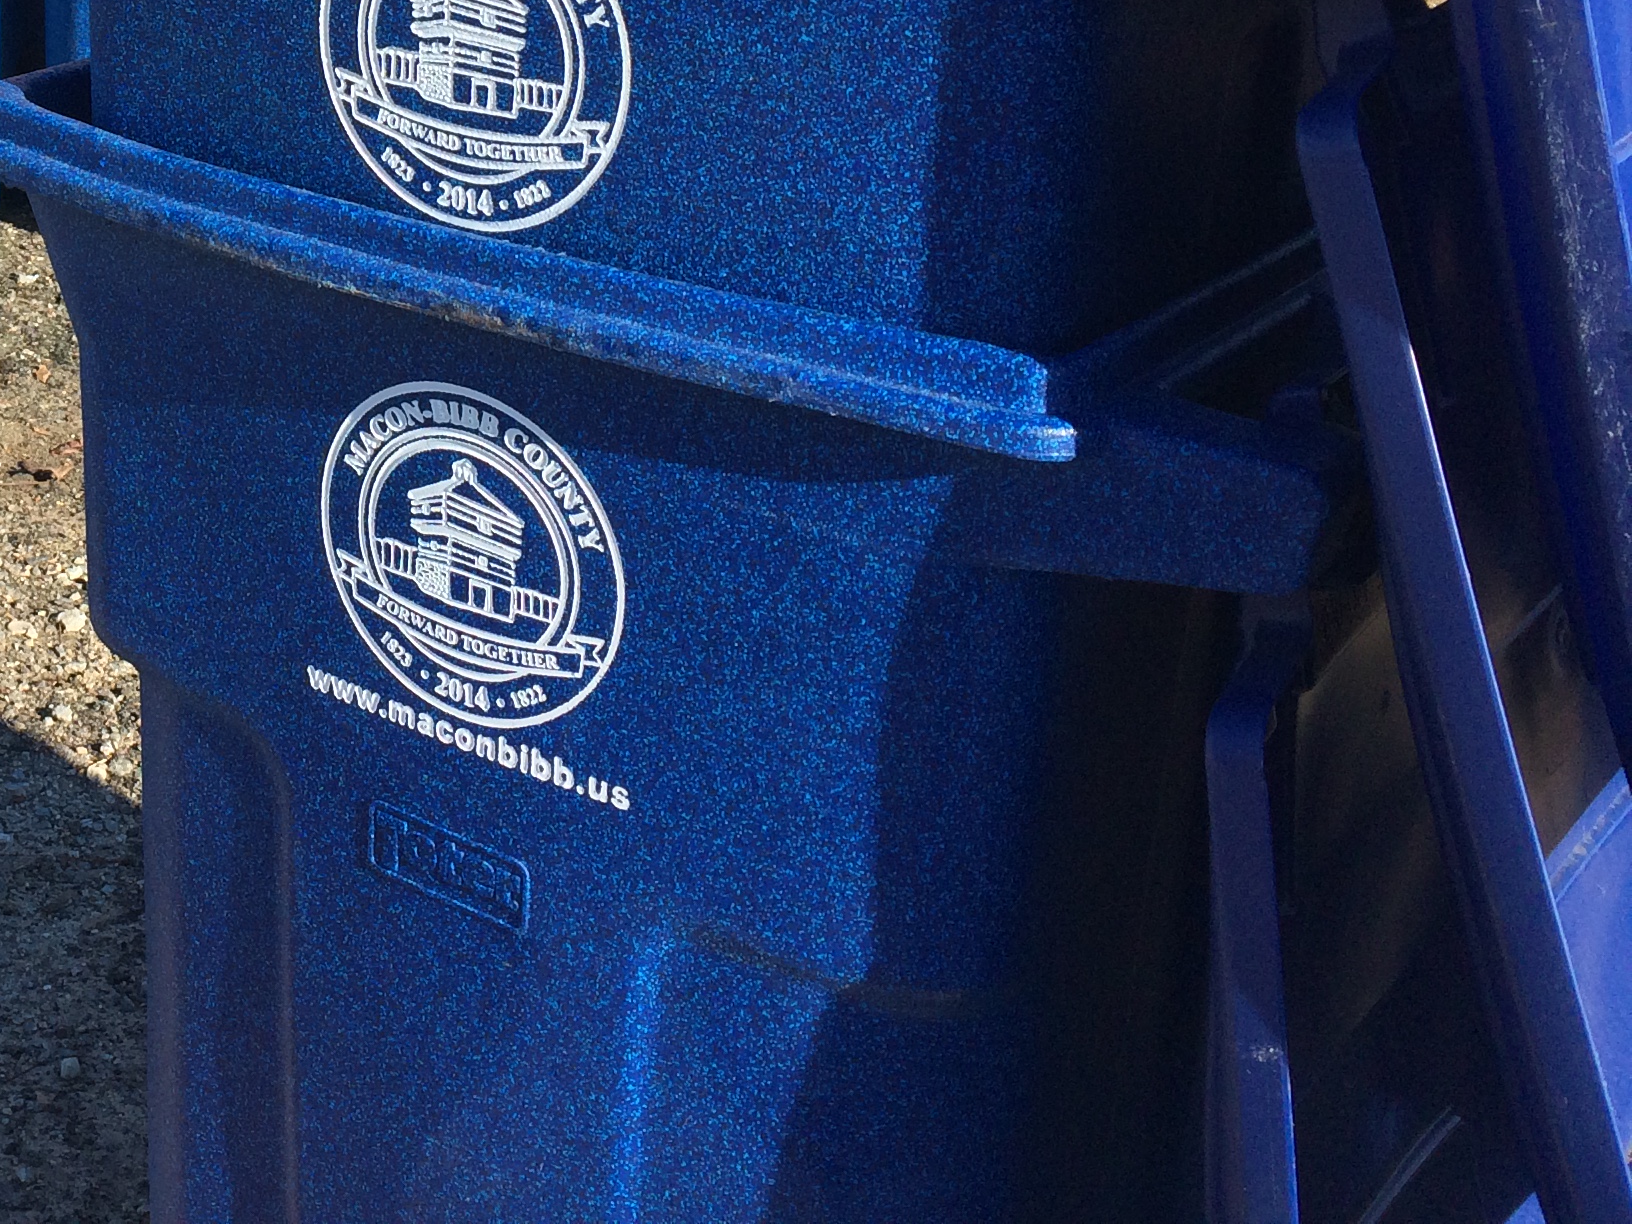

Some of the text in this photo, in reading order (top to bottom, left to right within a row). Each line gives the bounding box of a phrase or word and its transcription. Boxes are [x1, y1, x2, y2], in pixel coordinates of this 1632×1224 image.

[377, 111, 564, 163] FORWARD TOGETHER
[437, 183, 494, 216] 2014
[344, 398, 605, 553] MACON-BIBB COUNTY
[376, 595, 560, 671] FORWARD TOGETHER
[433, 671, 490, 712] 2014
[307, 665, 631, 811] www.maconbibb.us
